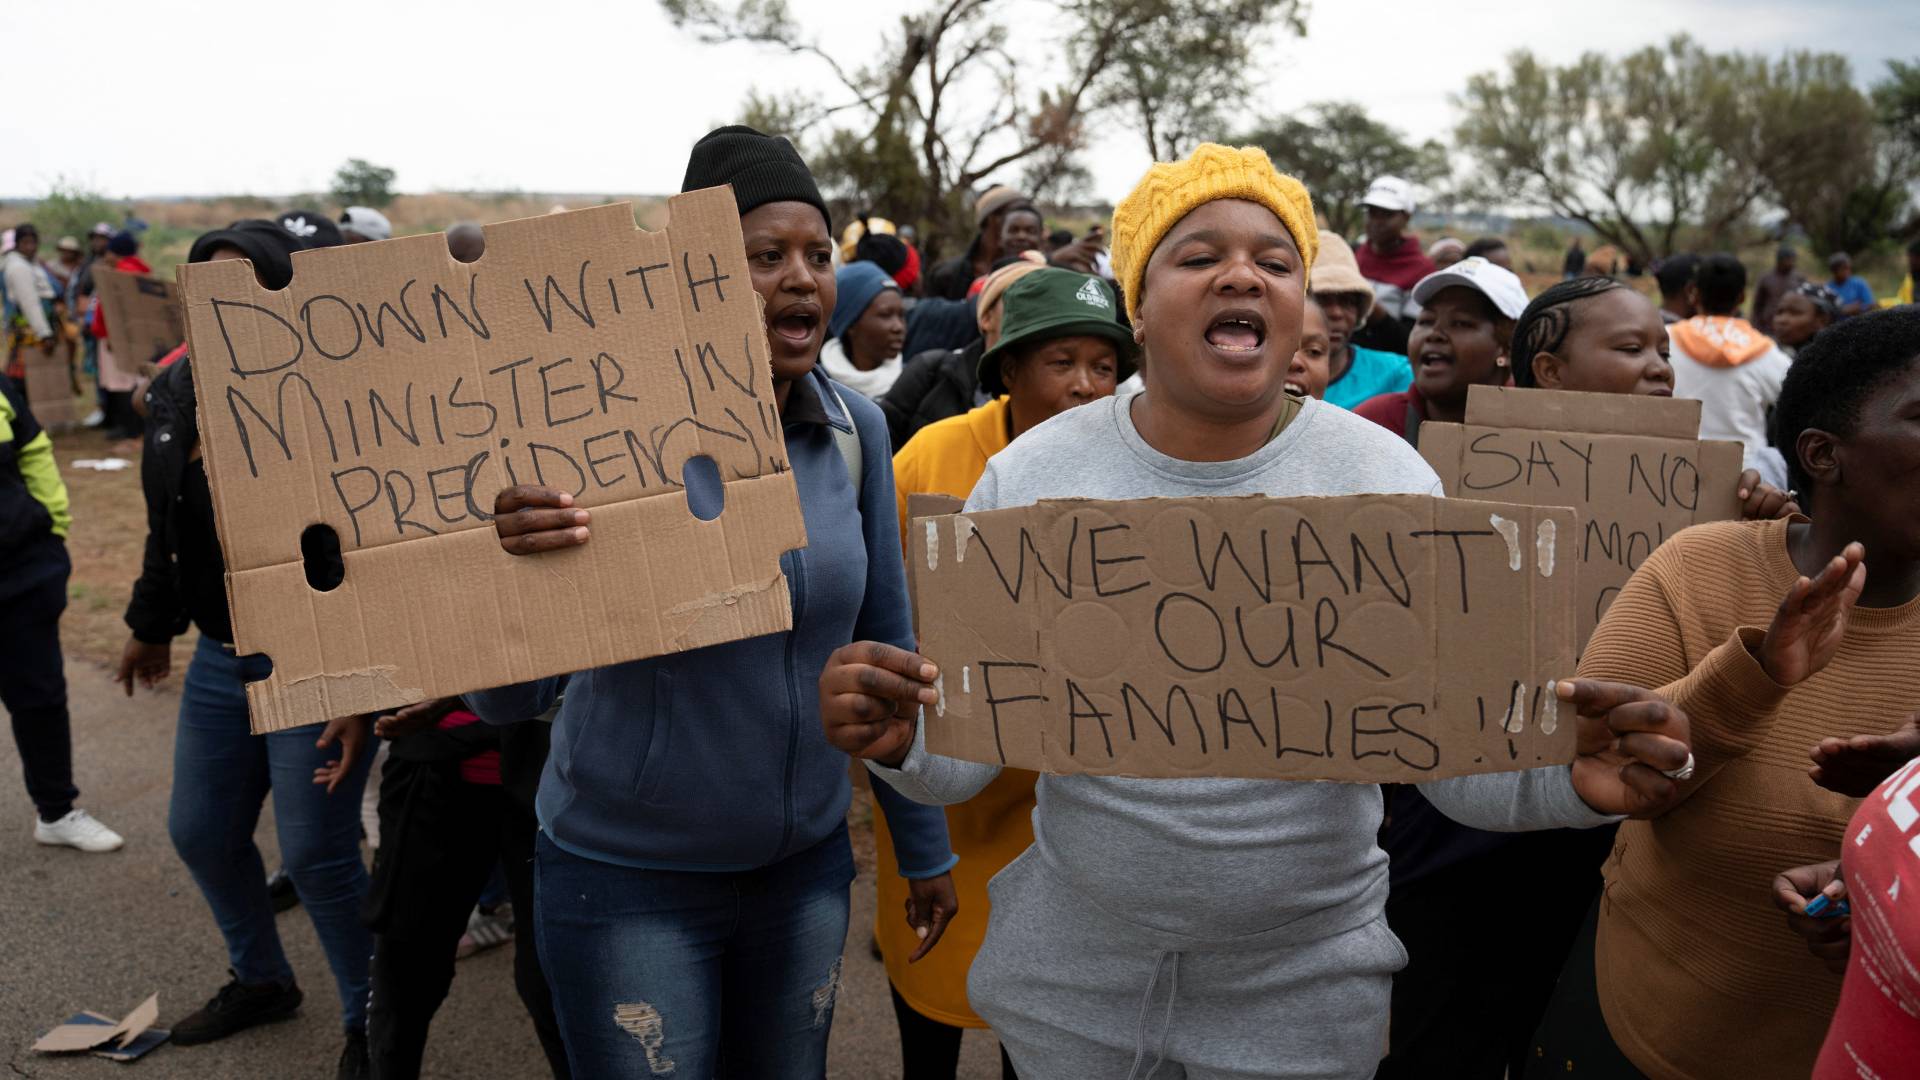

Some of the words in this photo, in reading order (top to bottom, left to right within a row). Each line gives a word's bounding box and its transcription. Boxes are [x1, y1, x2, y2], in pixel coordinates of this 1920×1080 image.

[211, 273, 490, 379] DOWN
[524, 252, 731, 333] WITH
[227, 352, 638, 478] MINISTER
[675, 333, 758, 415] IN
[1463, 432, 1593, 502] SAY
[1628, 452, 1700, 511] NO
[970, 516, 1151, 603] WE
[1189, 517, 1494, 614] WANT
[1154, 591, 1391, 678] OUR
[978, 660, 1439, 770] FAMALIES
